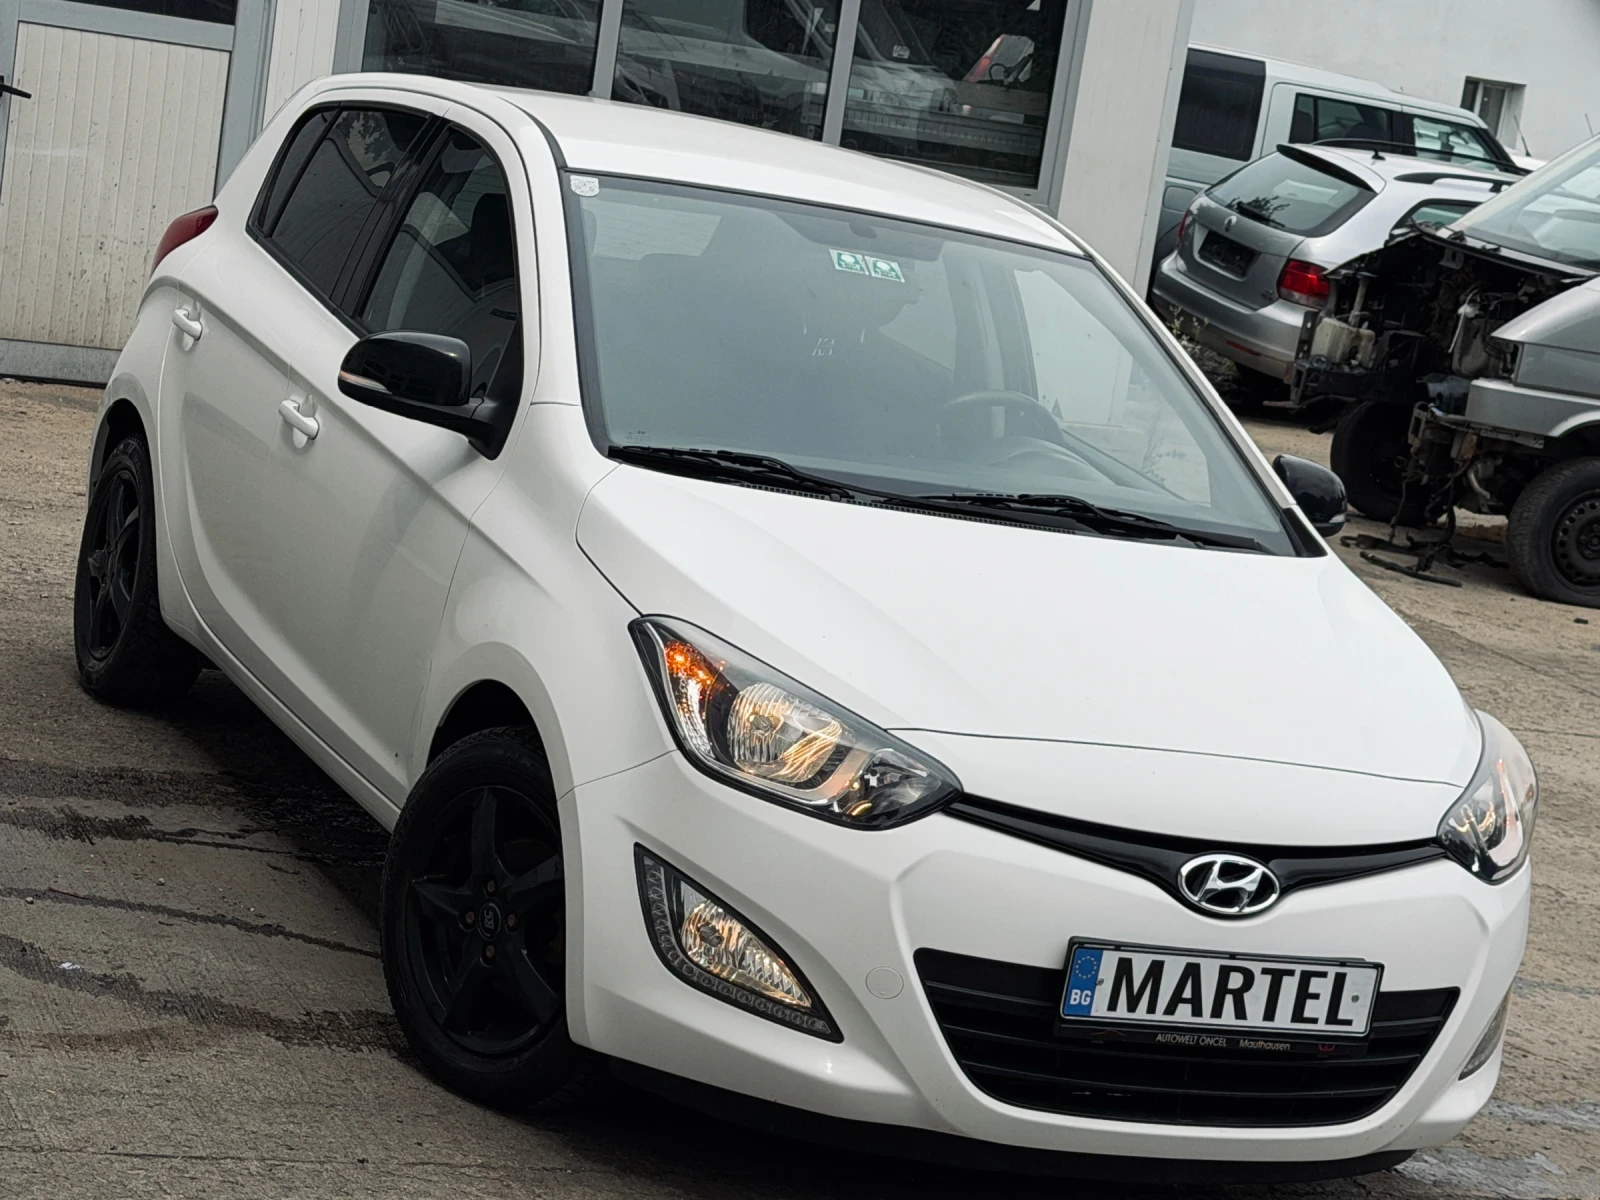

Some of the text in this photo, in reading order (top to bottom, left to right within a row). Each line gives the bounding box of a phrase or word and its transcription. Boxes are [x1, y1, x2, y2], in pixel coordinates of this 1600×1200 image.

[1069, 989, 1092, 1006] BG
[1106, 956, 1354, 1027] MARTEL
[1155, 1033, 1291, 1051] AUTOWELT ONCEL Mauthausen
